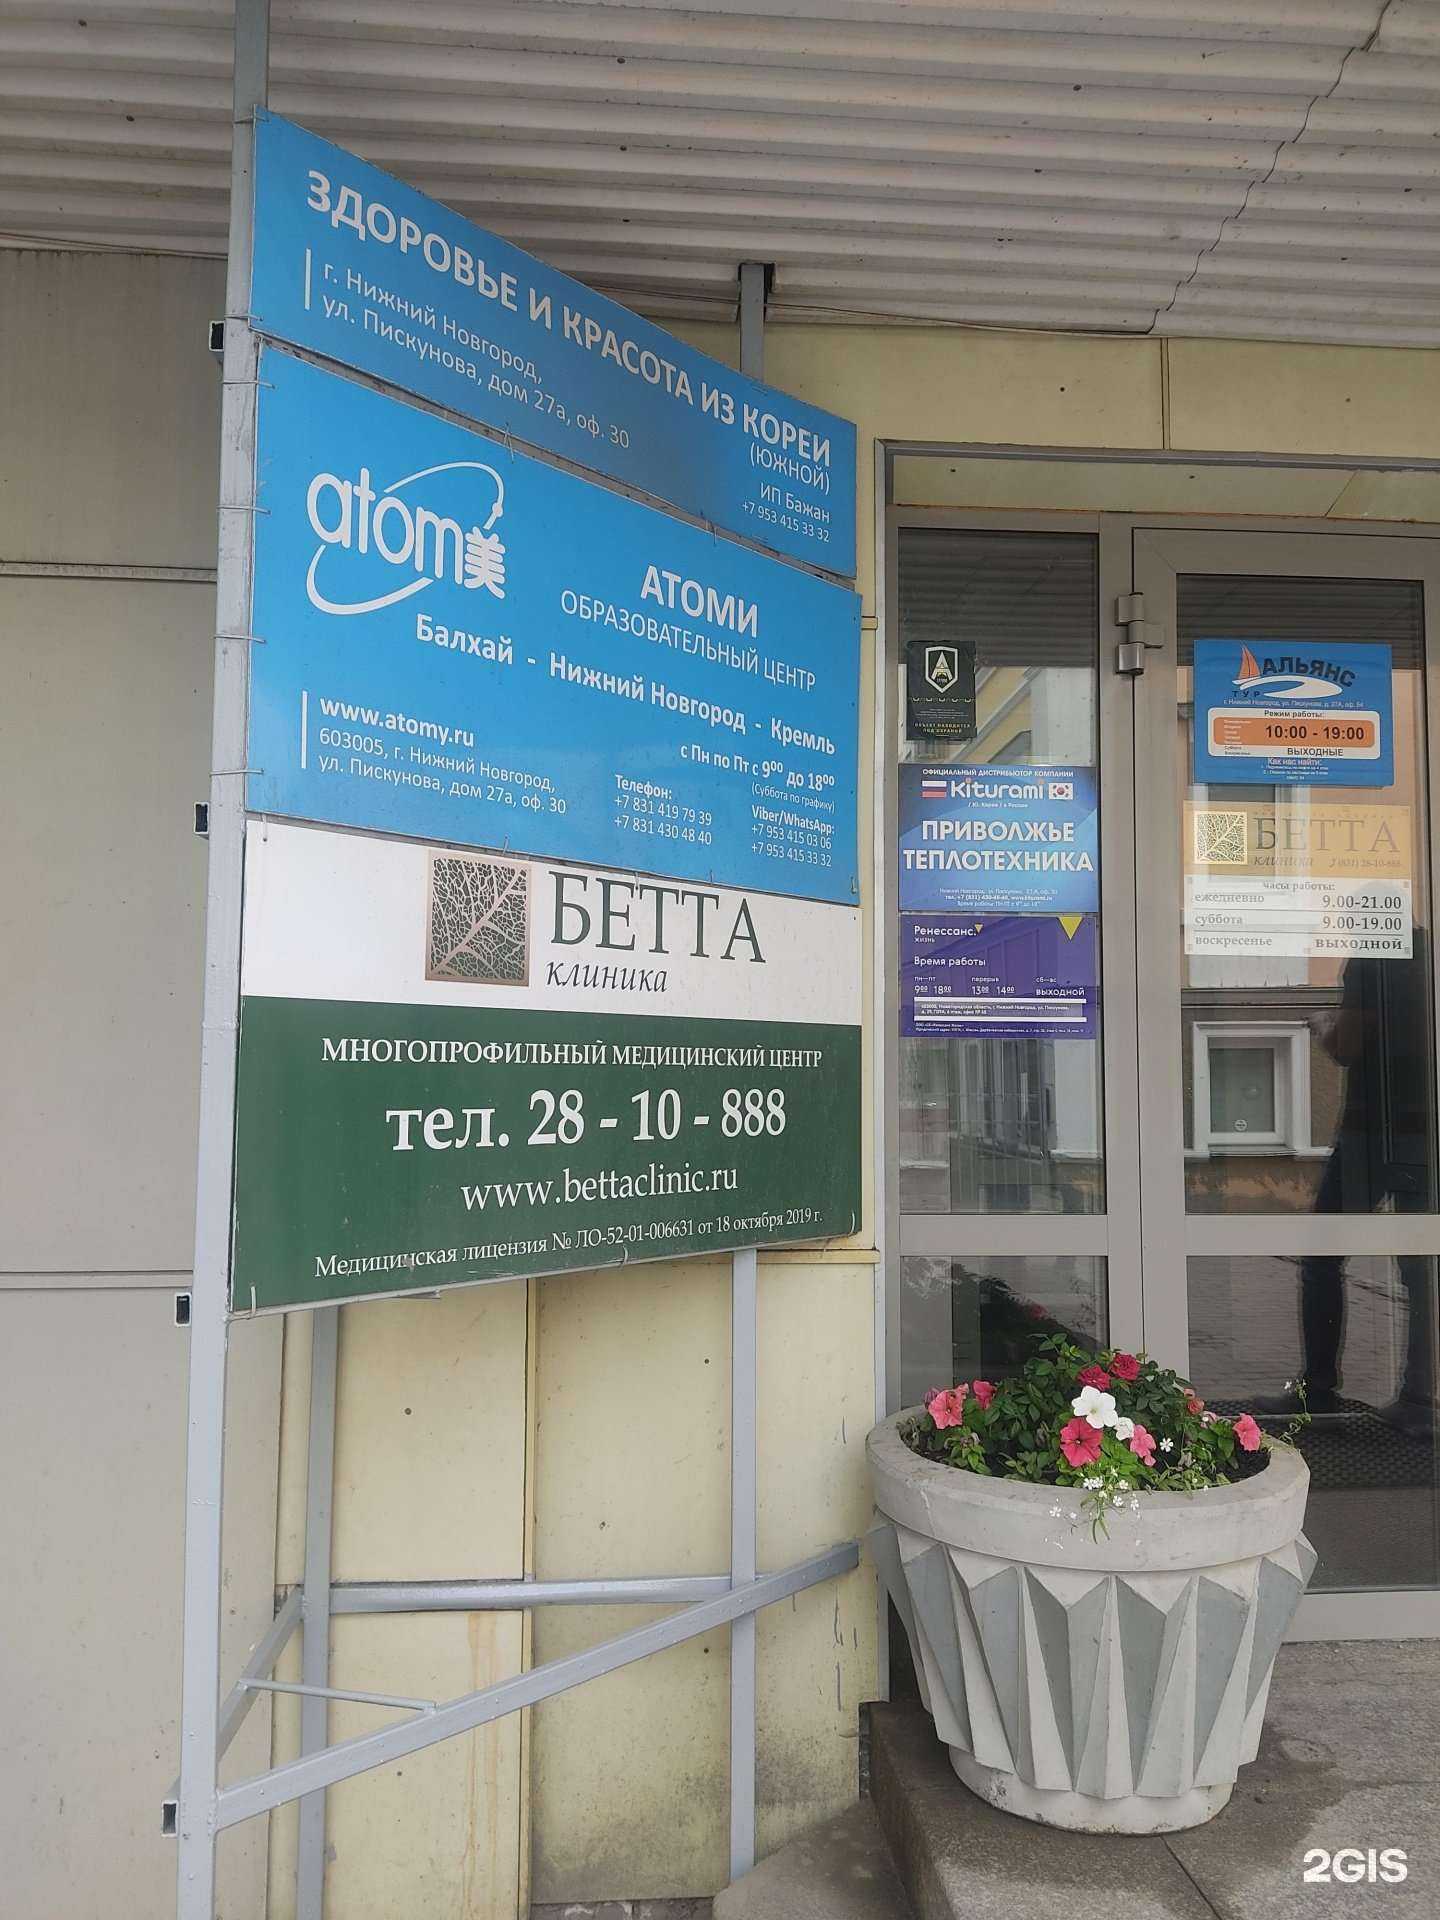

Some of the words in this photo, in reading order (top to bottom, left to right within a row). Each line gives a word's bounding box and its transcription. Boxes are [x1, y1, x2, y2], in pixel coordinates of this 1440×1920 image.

[307, 170, 518, 312] ЗДОРОВЬЕ
[529, 287, 552, 330] И
[563, 305, 694, 406] КРАСОТА
[701, 382, 735, 425] ИЗ
[743, 403, 831, 467] КОРЕИ
[323, 263, 338, 284] г.
[347, 268, 437, 330] Нижний
[443, 316, 543, 385] Новгород,
[322, 295, 355, 324] ул.
[364, 309, 483, 385] Пискунова,
[487, 374, 528, 405] дом
[533, 389, 571, 427] 27а,
[576, 412, 605, 438] оф.
[609, 424, 630, 450] 30
[750, 442, 830, 495] (ЮЖНОЙ)
[760, 482, 782, 506] ИП
[785, 491, 831, 523] Бажан
[742, 501, 755, 516] +7
[758, 505, 777, 523] 953
[780, 510, 800, 532] 415
[801, 516, 815, 537] 33
[817, 522, 830, 543] 32
[640, 565, 759, 638] АТОМИ
[560, 589, 759, 675] ОБРАЗОВАТЕЛЬНЫЙ
[763, 657, 816, 692] ЦЕНТР
[416, 613, 513, 665] Балхай
[549, 652, 645, 702] Нижний
[651, 681, 746, 735] Новгород
[770, 717, 836, 756] Кремль
[1262, 656, 1358, 688] АЛЬЯНС
[1232, 690, 1261, 698] ТУР
[319, 697, 475, 748] www.atomy.ru
[1266, 725, 1307, 739] 10:00
[1323, 726, 1365, 740] 19:00
[319, 727, 388, 760] 603005,
[394, 747, 404, 761] г.
[410, 745, 475, 775] Нижний
[480, 761, 556, 794] Новгород,
[680, 744, 688, 759] с
[691, 744, 710, 765] Пн
[713, 752, 730, 770] по
[733, 754, 749, 774] Пт
[752, 762, 759, 777] с
[786, 771, 804, 788] до
[1287, 747, 1344, 757] ВЫХОДНЫЕ
[318, 754, 344, 773] ул.
[350, 758, 446, 795] Пискунова,
[449, 780, 482, 799] дом
[486, 785, 517, 808] 27а,
[521, 792, 545, 813] оф.
[549, 796, 566, 815] 30
[615, 774, 673, 801] Телефон:
[922, 768, 977, 777] ОФИЦИАЛЬНЫЙ
[978, 769, 1033, 778] ДИСТРИБЬЮТОР
[1034, 770, 1074, 778] КОМПАНИИ
[614, 794, 630, 810] +7
[633, 796, 654, 816] 831
[657, 800, 679, 820] 419
[682, 806, 696, 824] 79
[698, 810, 713, 827] 39
[751, 782, 788, 803] (Суббота
[789, 792, 800, 805] по
[801, 796, 836, 815] графику)
[614, 814, 630, 830] +7
[633, 817, 654, 835] 831
[657, 821, 679, 840] 430
[681, 825, 696, 843] 48
[697, 829, 713, 846] 40
[751, 804, 836, 836] Viber/WhatsApp:
[751, 822, 764, 838] +7
[766, 824, 785, 841] 953
[786, 828, 805, 846] 415
[806, 832, 819, 848] 03
[820, 835, 832, 851] 06
[922, 820, 1074, 842] ПРИВОЛЖЬЕ
[1253, 817, 1401, 852] БЕТТА
[751, 841, 764, 856] +7
[766, 843, 785, 859] 953
[786, 846, 805, 863] 415
[806, 850, 819, 867] 33
[820, 852, 832, 868] 32
[903, 849, 1094, 872] ТЕПЛОТЕХНИКА
[1194, 893, 1265, 904] ежедневно
[1322, 895, 1402, 909] 9.00-21.00
[1292, 881, 1336, 892] работы:
[548, 870, 767, 964] БЕТТА
[1194, 913, 1243, 927] суббота
[1322, 916, 1402, 931] 9.00-19.00
[1194, 936, 1273, 947] воскресенье
[1315, 937, 1403, 951] выходной
[546, 959, 668, 992] клиника
[914, 956, 946, 967] Время
[948, 956, 986, 967] работы
[321, 1037, 607, 1066] МНОГОПРОФИЛЬНЫЙ
[611, 1044, 765, 1070] МЕДИЦИНСКИЙ
[769, 1049, 823, 1070] ЦЕНТР
[385, 1107, 510, 1151] тел.
[527, 1089, 585, 1146] 28
[631, 1088, 682, 1141] 10
[721, 1088, 786, 1138] 888
[460, 1162, 738, 1211] www.bettaclinic.ru
[314, 1247, 458, 1278] Медицинская
[462, 1238, 548, 1262] лицензия
[551, 1231, 572, 1250] №
[575, 1219, 694, 1248] ЛО-52-01-006631
[698, 1222, 713, 1235] от
[716, 1216, 730, 1232] 18
[733, 1210, 783, 1233] октября
[786, 1207, 812, 1225] 2019
[814, 1211, 823, 1222] г.
